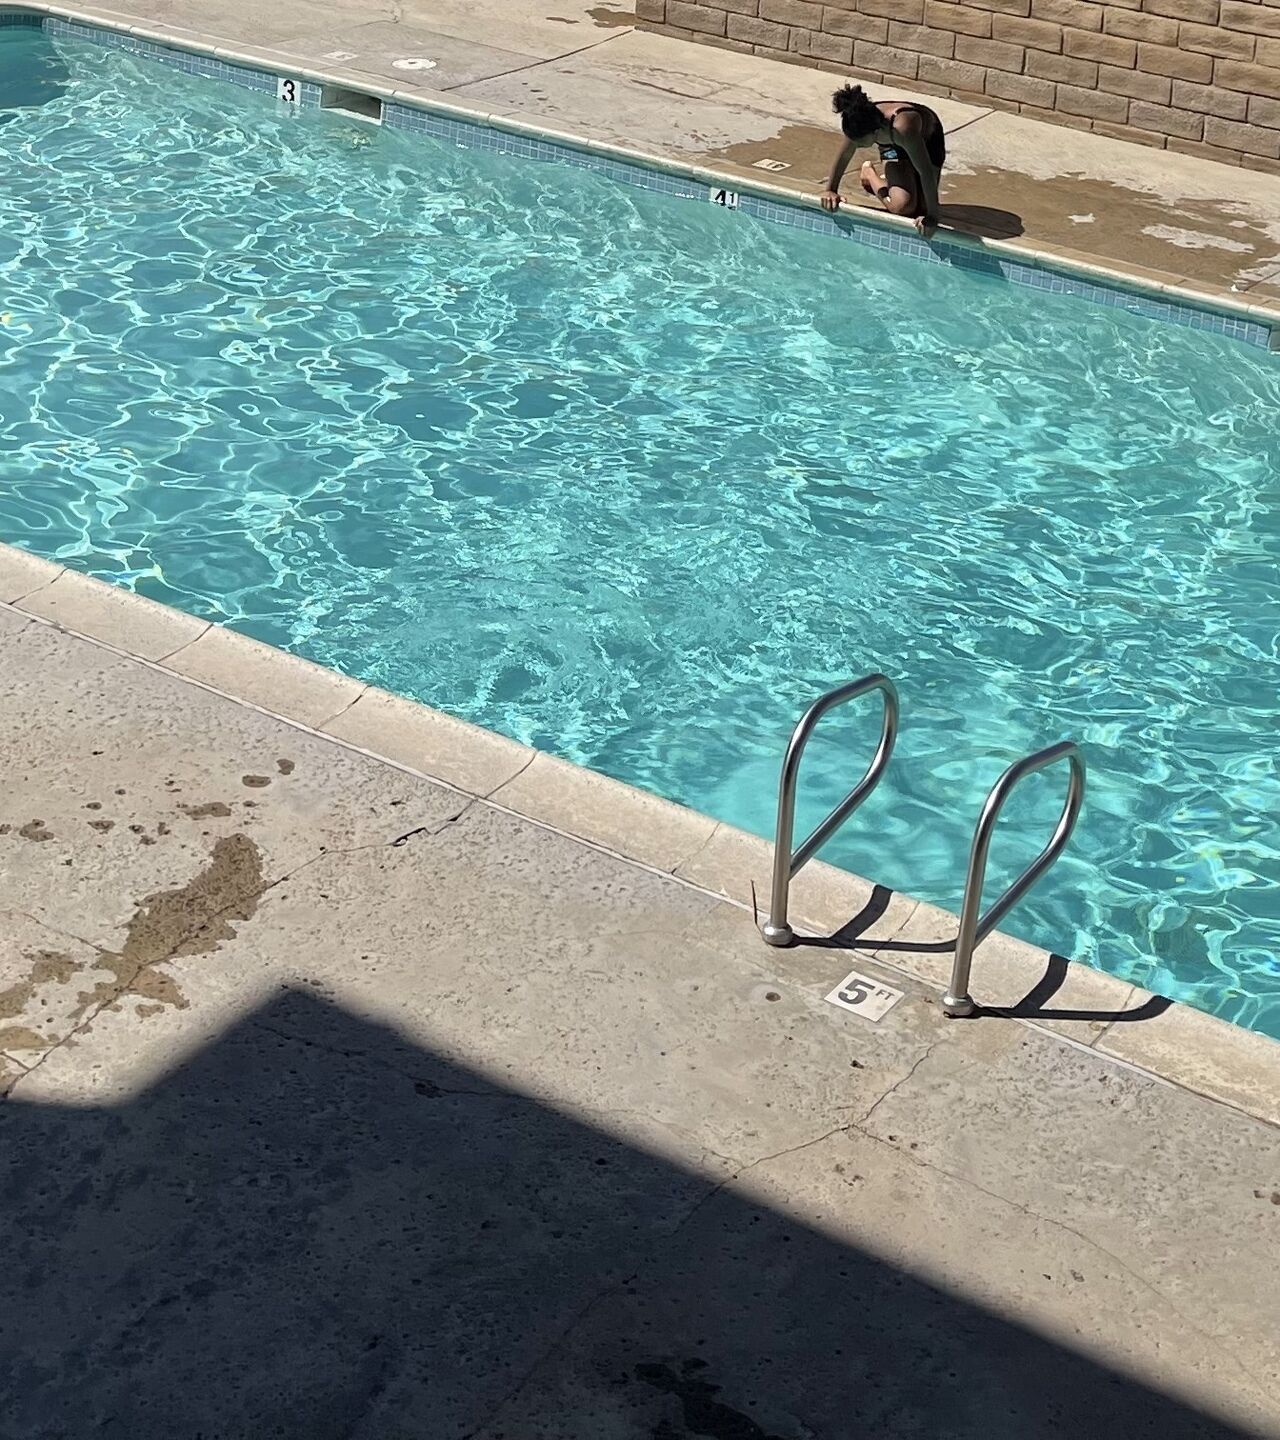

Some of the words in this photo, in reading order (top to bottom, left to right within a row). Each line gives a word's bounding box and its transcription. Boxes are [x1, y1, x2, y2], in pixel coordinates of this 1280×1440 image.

[282, 79, 295, 102] 3
[838, 979, 876, 1005] 5
[875, 989, 896, 1001] FT
